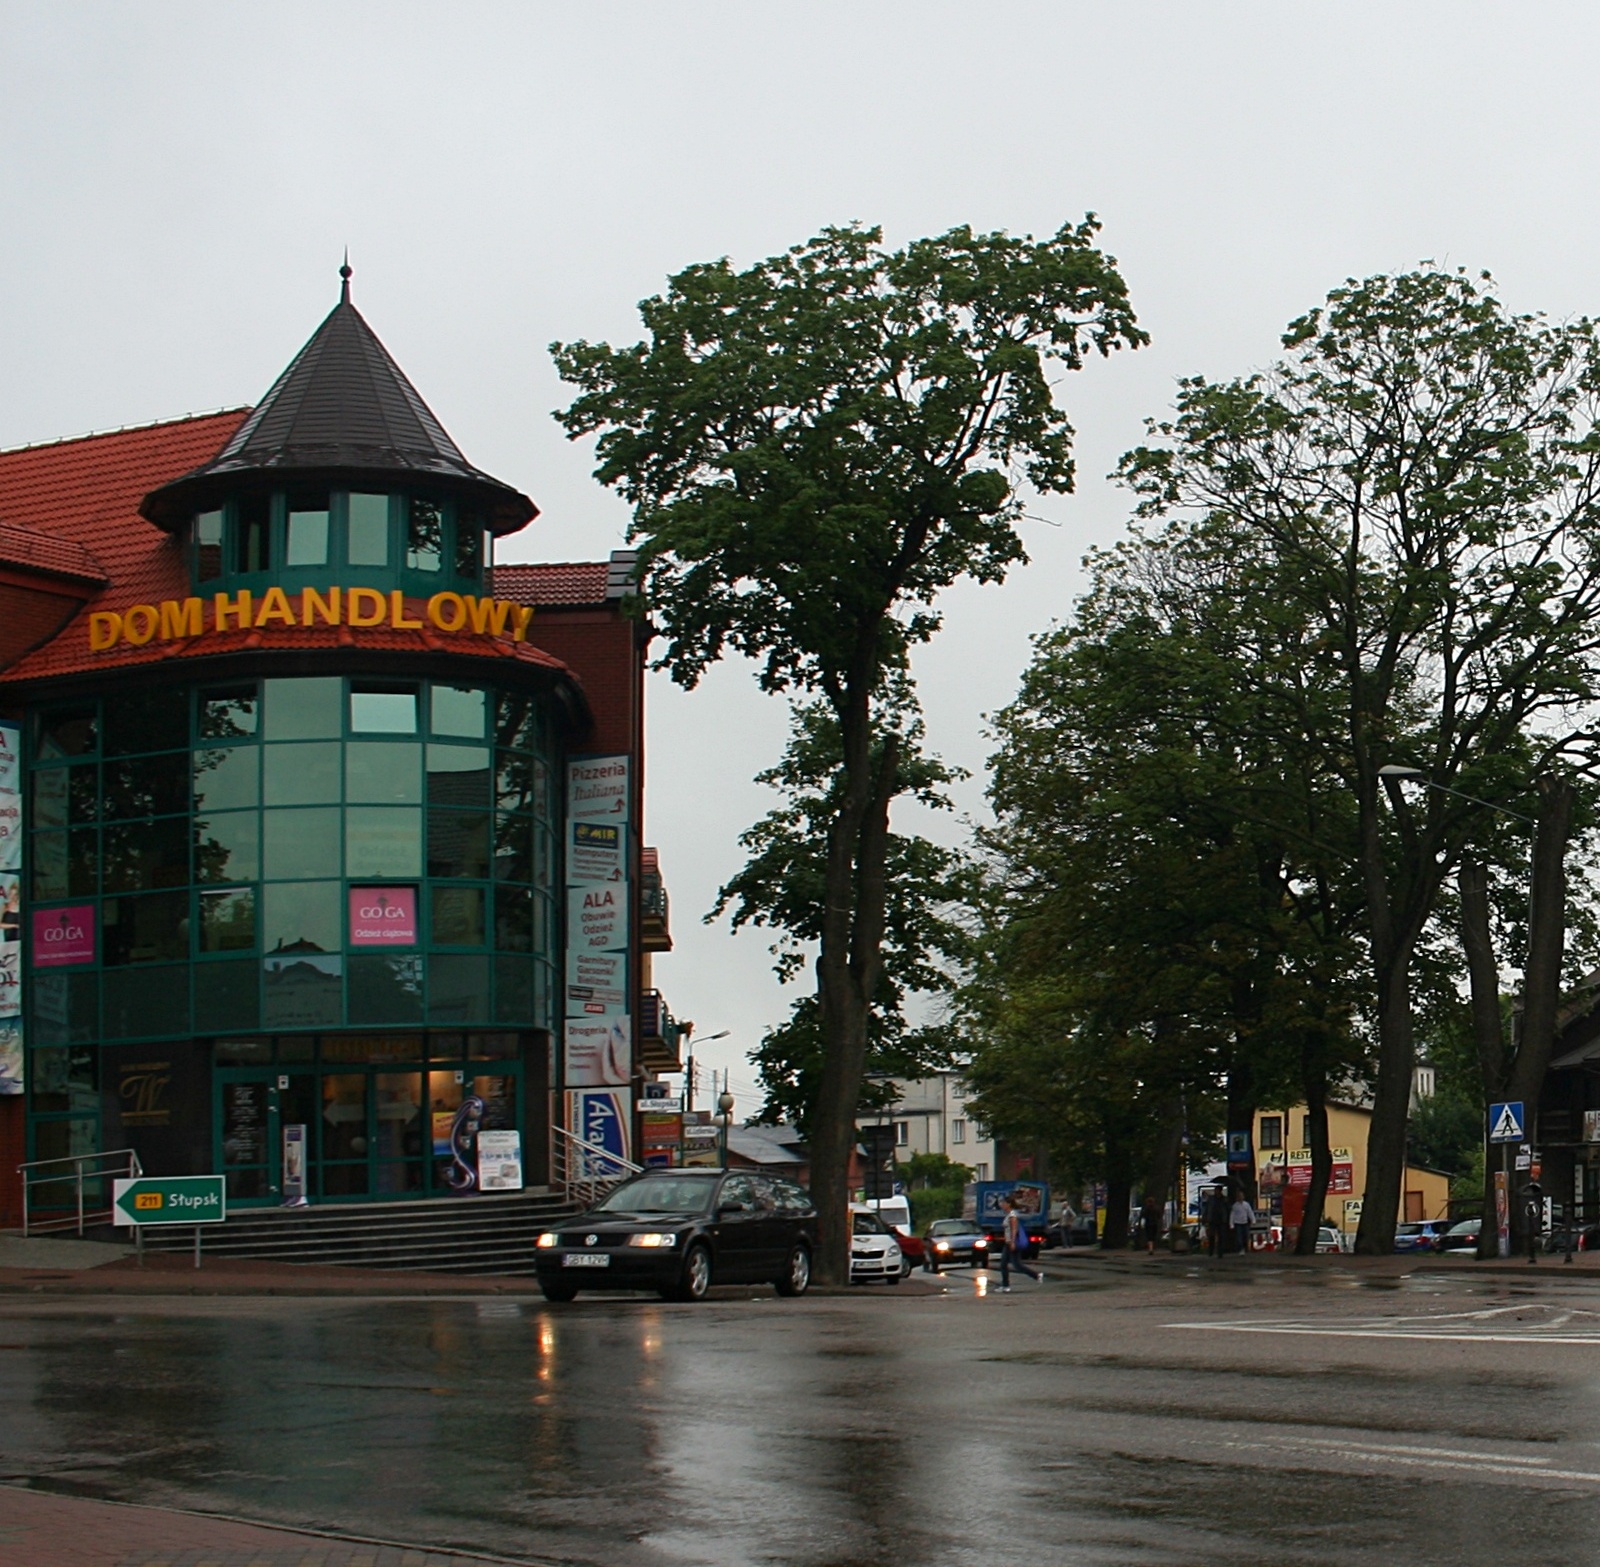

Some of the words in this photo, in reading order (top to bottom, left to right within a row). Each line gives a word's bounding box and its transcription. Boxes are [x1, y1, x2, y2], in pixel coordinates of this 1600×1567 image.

[90, 596, 201, 651] DOM
[215, 586, 534, 642] HANDLOWY
[571, 763, 625, 781] Pizzeria
[574, 784, 625, 801] Italiana
[583, 890, 614, 909] ALA
[581, 910, 615, 922] Obuwie
[583, 923, 613, 935] Odzież
[588, 936, 608, 947] AGD
[568, 1026, 607, 1037] Drogeria
[1290, 1148, 1349, 1161] RESTCJA
[141, 1195, 158, 1207] 211
[168, 1192, 219, 1209] Słupsk
